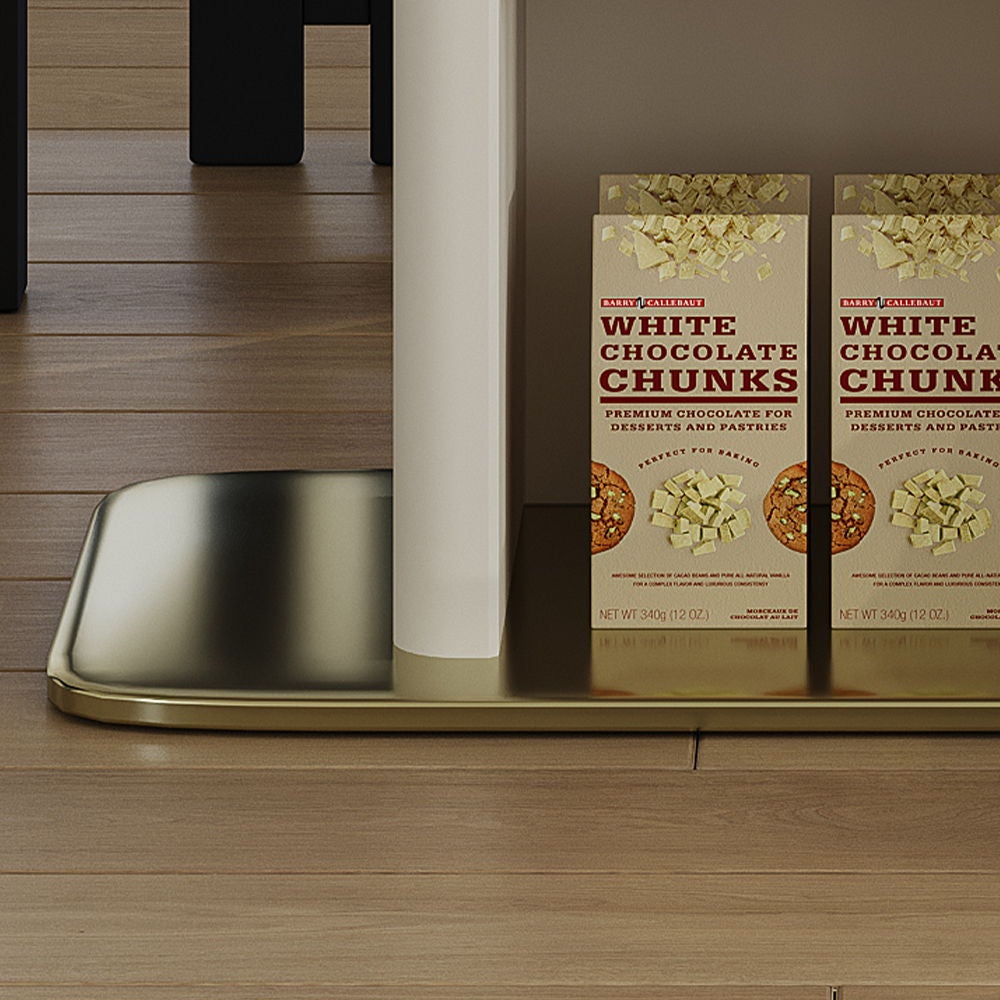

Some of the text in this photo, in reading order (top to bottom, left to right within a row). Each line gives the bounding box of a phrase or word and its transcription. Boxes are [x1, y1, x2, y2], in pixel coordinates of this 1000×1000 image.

[602, 299, 703, 307] BARRY CALLEBAUT
[842, 299, 942, 307] BARRY CALLEBAUT
[600, 316, 737, 336] WHITE
[839, 316, 977, 336] WHITE
[599, 344, 798, 361] CHOCOLATE
[599, 368, 799, 393] CHUNKS
[605, 409, 793, 419] PREMIUM CHOCOLATE FOR
[845, 409, 913, 419] PREMIUM
[916, 409, 1000, 419] CHOCOLATE
[610, 423, 788, 432] DESSERTS AND PASTRIES
[850, 423, 922, 432] DESSERTS
[925, 423, 956, 432] AND
[638, 448, 686, 469] PERFECT
[718, 448, 760, 469] BAKING
[878, 448, 926, 469] PERFECT
[958, 448, 1000, 469] BAKING
[599, 608, 620, 620] NET
[621, 608, 638, 620] WT
[640, 608, 667, 622] 340g
[669, 608, 686, 622] (12
[839, 608, 860, 620] NET
[861, 608, 878, 620] WT
[880, 608, 907, 622] 340g
[909, 608, 926, 622] (12
